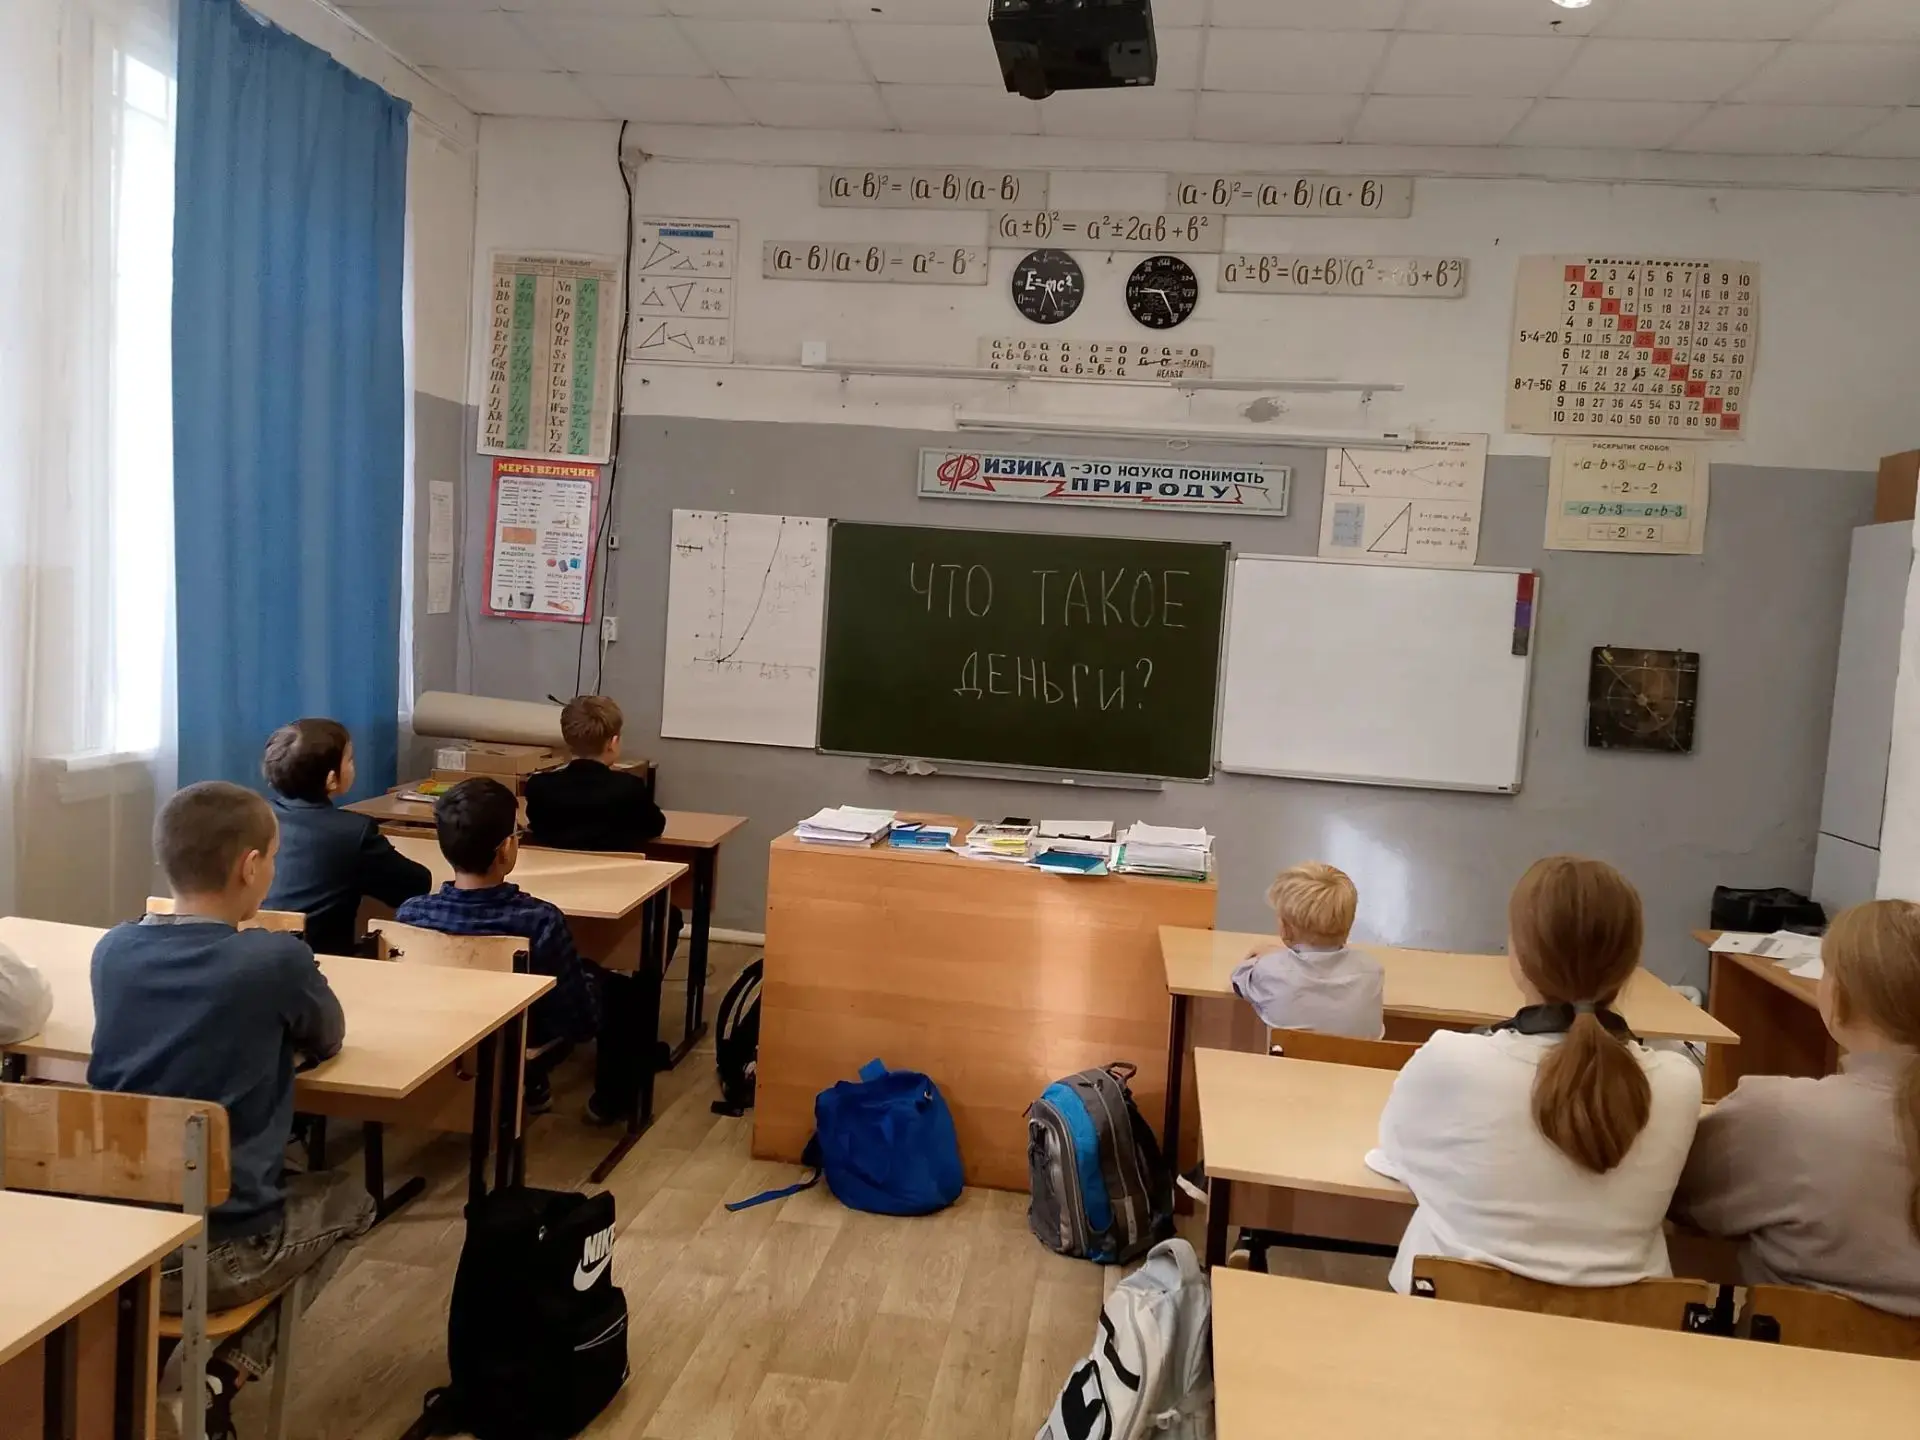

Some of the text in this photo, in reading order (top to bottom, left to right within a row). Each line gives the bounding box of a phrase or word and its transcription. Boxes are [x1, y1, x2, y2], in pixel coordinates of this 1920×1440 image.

[495, 277, 511, 288] Aa
[1589, 268, 1597, 280] 2
[1609, 269, 1616, 280] 3
[1627, 269, 1635, 281] 4
[1647, 270, 1654, 282] 5
[1666, 271, 1673, 282] 6
[1684, 271, 1691, 283] 7
[1703, 272, 1710, 284] 8
[1722, 273, 1728, 284] 9
[1739, 274, 1749, 286] 10
[556, 281, 571, 292] Nn
[1569, 283, 1749, 301] 2 6 8 10 12 14 16 18 20
[496, 290, 510, 301] Bb
[556, 294, 571, 306] Oo
[495, 304, 509, 315] Cc
[1568, 299, 1748, 316] 3 6 12 15 18 21 24 27 30
[555, 308, 570, 322] Pp
[494, 317, 510, 329] Dd
[554, 322, 570, 336] Qq
[1565, 315, 1747, 332] 4 8 12 20 24 28 32 36 40
[494, 331, 508, 342] Ee
[554, 336, 570, 346] Rr
[1564, 331, 1571, 344] 5
[1582, 333, 1592, 343] 10
[1602, 333, 1611, 343] 15
[1619, 334, 1631, 344] 20
[1658, 335, 1669, 345] 30
[1677, 336, 1688, 346] 35
[1695, 336, 1707, 346] 40
[1713, 337, 1726, 347] 45
[1733, 338, 1745, 348] 50
[492, 344, 508, 358] Ff
[553, 349, 567, 360] Ss
[1562, 347, 1744, 364] 6 12 18 24 30 42 48 54 60
[491, 357, 507, 370] Gg
[552, 363, 566, 373] Tt
[490, 371, 506, 381] Hh
[1561, 363, 1568, 375] 7
[1579, 365, 1588, 375] 14
[1596, 365, 1606, 375] 21
[1615, 366, 1628, 376] 28
[1653, 367, 1666, 377] 42
[1692, 368, 1703, 378] 56
[1710, 369, 1722, 379] 63
[1730, 369, 1741, 379] 70
[552, 375, 567, 387] Uu
[1558, 379, 1566, 390] 8
[1577, 381, 1586, 390] 16
[1594, 381, 1605, 391] 24
[1613, 382, 1625, 392] 32
[1631, 382, 1644, 392] 40
[1650, 383, 1663, 393] 48
[1670, 384, 1682, 394] 56
[1709, 385, 1720, 395] 72
[1727, 386, 1739, 395] 80
[552, 389, 566, 400] Vv
[488, 397, 501, 410] Jj
[550, 403, 569, 414] Ww
[1557, 395, 1737, 411] 9 18 27 36 45 54 63 72 90
[487, 410, 503, 421] Kk
[548, 416, 566, 427] Xx
[1553, 410, 1716, 426] 10 20 30 40 50 60 70 80 90
[486, 424, 500, 434] Ll
[549, 429, 562, 438] Yy
[484, 437, 504, 448] Mm
[548, 442, 562, 453] Zz
[498, 463, 596, 477] МЕРЫ ВЕЛИЧИН
[936, 453, 1066, 491] ФИЗИКА
[1071, 477, 1230, 499] ПРИРОДУ
[910, 562, 1190, 629] ЧТО ТАКОЕ
[952, 651, 1153, 711] ДЕНЬГИ?
